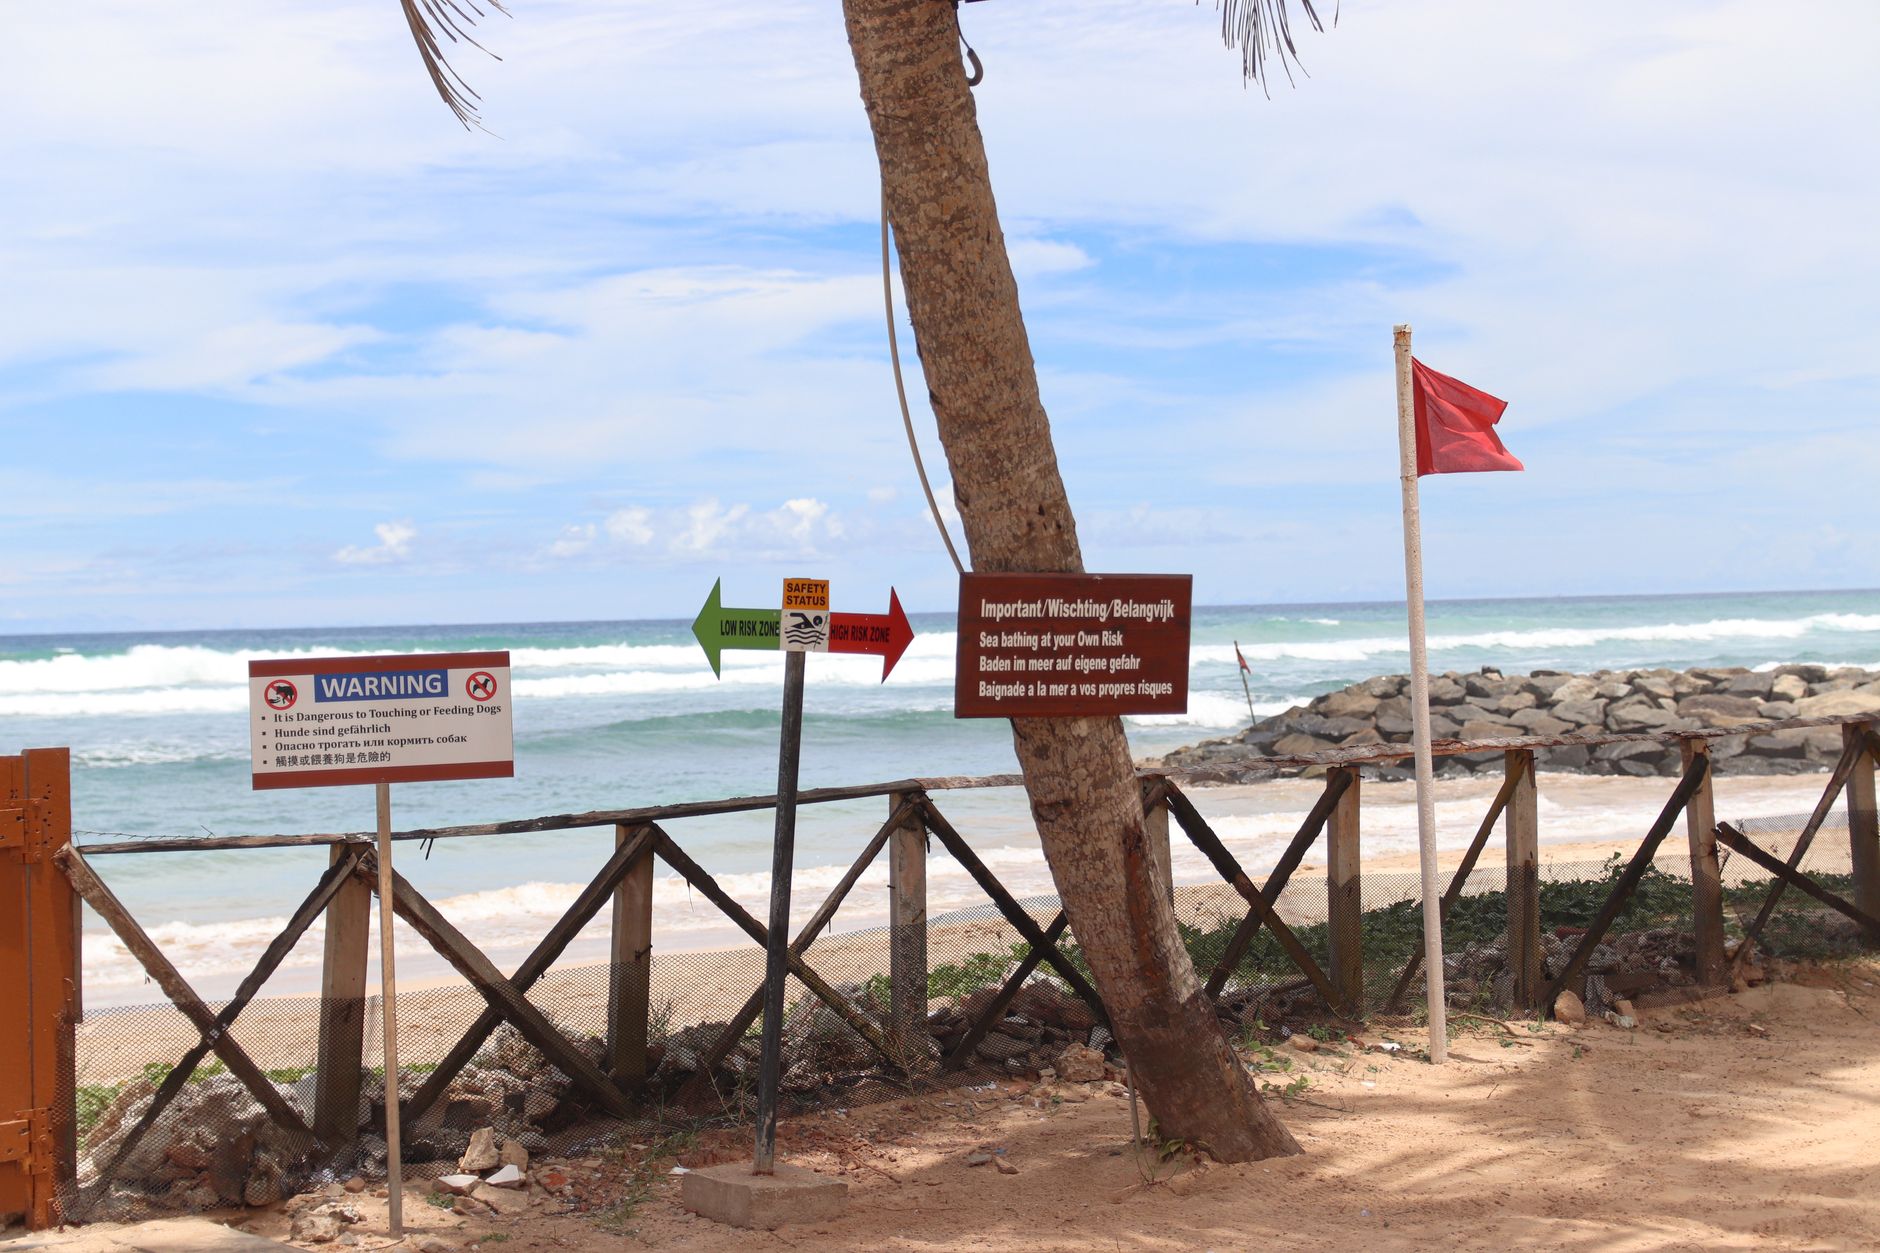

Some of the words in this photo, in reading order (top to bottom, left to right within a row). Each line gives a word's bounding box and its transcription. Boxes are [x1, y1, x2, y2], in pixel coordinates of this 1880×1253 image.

[786, 582, 826, 594] SAFETY
[786, 595, 826, 606] STATUS
[720, 620, 737, 636] LOW
[739, 620, 757, 637] RISK
[759, 621, 780, 638] ZONE
[830, 626, 849, 640] HIGH
[851, 626, 868, 643] RISK
[870, 627, 890, 643] ZONE
[979, 631, 998, 647] Sea
[1001, 631, 1038, 651] bathing
[1041, 631, 1051, 647] at
[1053, 634, 1075, 651] your
[1078, 630, 1099, 647] Own
[1102, 630, 1123, 646] Risk
[979, 655, 1011, 672] Baden
[1013, 655, 1026, 671] im
[1028, 659, 1054, 671] meer
[1056, 654, 1072, 671] auf
[1074, 654, 1107, 674] eigene
[1109, 654, 1141, 674] gefahr
[321, 674, 442, 698] WARNING
[979, 681, 1025, 701] Baignade
[1028, 684, 1035, 696] a
[1037, 680, 1046, 696] la
[1049, 684, 1068, 696] mer
[1070, 684, 1077, 696] a
[1079, 683, 1096, 696] vos
[1099, 682, 1135, 699] propres
[1138, 679, 1172, 699] risques
[274, 713, 283, 722] It
[285, 712, 294, 722] is
[296, 712, 354, 723] Dangerous
[356, 710, 367, 719] to
[369, 708, 418, 719] Touching
[419, 708, 431, 716] or
[433, 705, 475, 717] Feeding
[476, 704, 502, 715] Dogs
[275, 727, 310, 738] Hunde
[312, 726, 335, 736] sind
[337, 723, 391, 735] gefährlich
[275, 742, 316, 751] Опасно
[317, 741, 361, 751] трогать
[363, 738, 385, 747] или
[387, 738, 434, 748] кормить
[436, 734, 467, 744] собак
